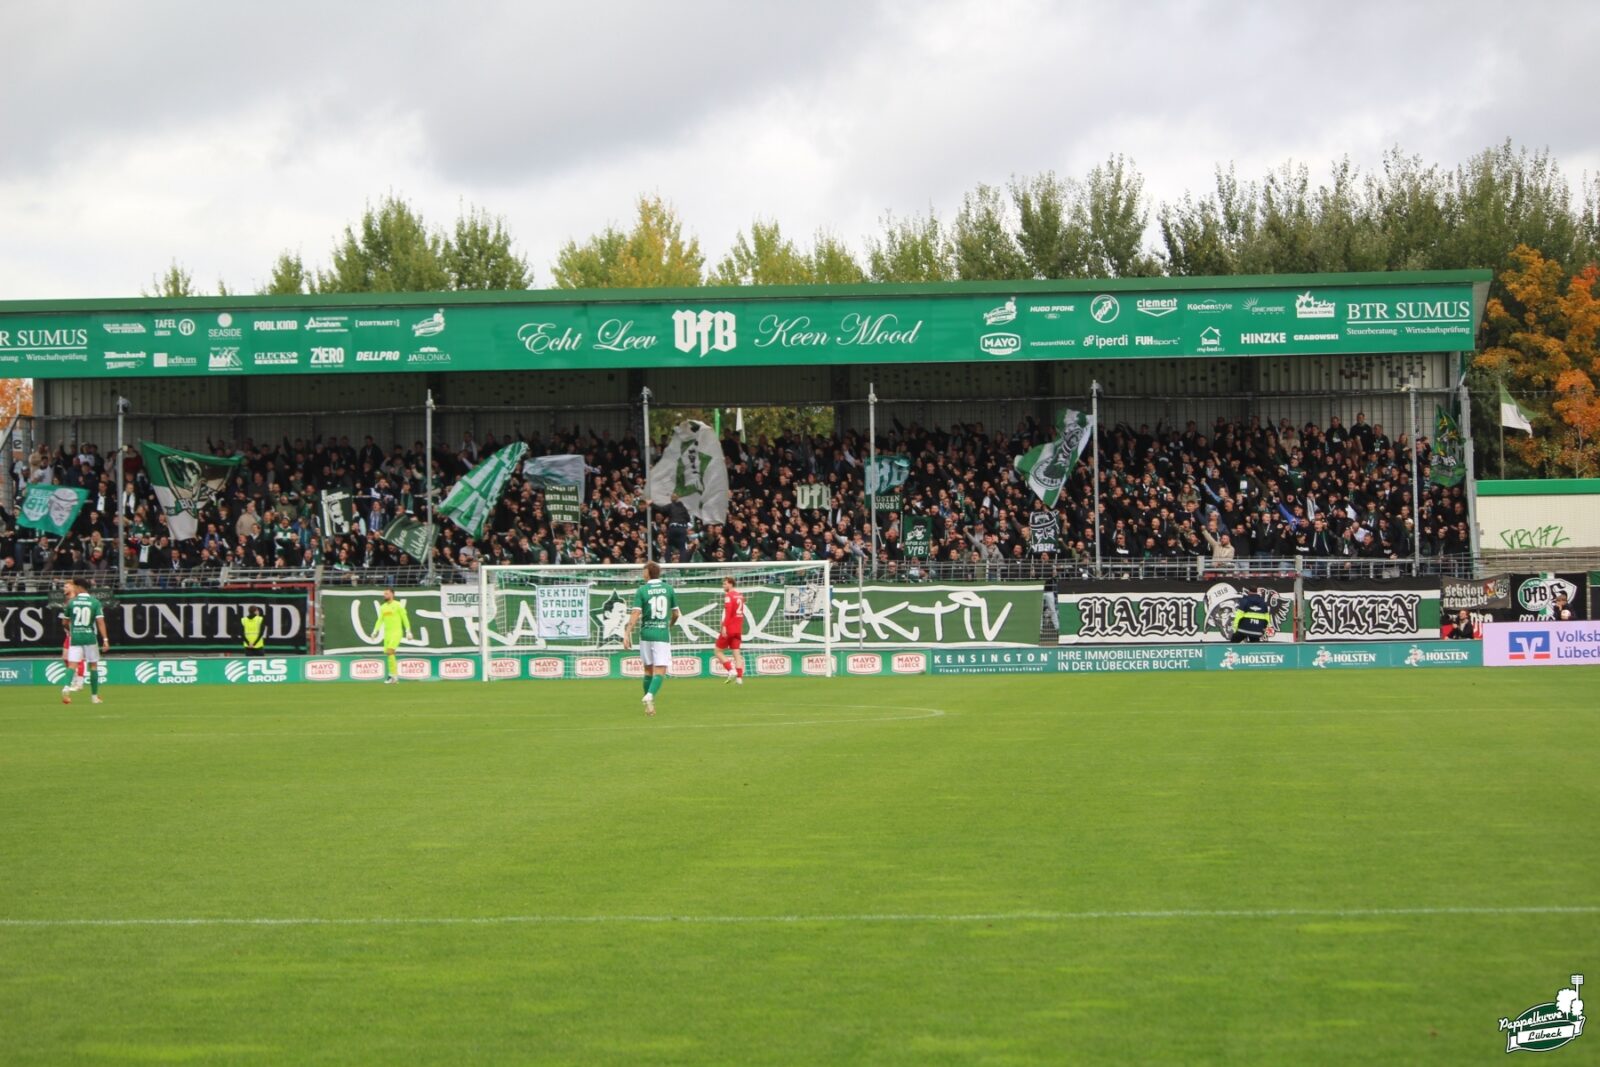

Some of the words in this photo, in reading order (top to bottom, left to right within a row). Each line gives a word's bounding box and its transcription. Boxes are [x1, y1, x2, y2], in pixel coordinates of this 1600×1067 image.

[1137, 298, 1178, 308] clement
[1187, 303, 1233, 312] Küchenstyle
[1346, 303, 1390, 319] BTR
[1395, 301, 1471, 319] SUMUS
[154, 319, 177, 328] TAFEL
[208, 328, 242, 337] SEASIDE
[672, 309, 737, 358] VfB
[754, 314, 831, 347] Keen
[836, 312, 924, 346] Mood
[1346, 327, 1398, 336] Steuerberatung
[1404, 326, 1471, 336] Wirtschaftsprüfung
[17, 329, 88, 346] SUMUS
[518, 322, 583, 354] Echt
[985, 337, 1017, 348] MAYO
[1096, 334, 1128, 348] iperdi
[1241, 332, 1287, 344] HINZKE
[356, 351, 400, 361] DELLPRO
[407, 353, 451, 362] JABLONKA
[540, 588, 586, 597] SEKTION
[542, 599, 583, 608] STADION
[648, 595, 668, 619] 19
[73, 606, 91, 626] 20
[542, 609, 583, 618] VERBOT
[1556, 630, 1600, 642] Volksb
[934, 653, 1048, 664] KENSINGTON
[1057, 650, 1081, 660] IHRE
[1084, 649, 1203, 660] IMMOBILIENEXPERTEN
[1241, 654, 1284, 664] HOLSTEN
[1333, 653, 1377, 663] HOLSTEN
[1425, 651, 1468, 662] HOLSTEN
[158, 660, 198, 676] FLS
[248, 659, 288, 675] FLS
[1057, 661, 1069, 670] IN
[1072, 661, 1093, 670] DER
[1096, 660, 1150, 671] LÜBECKER
[1153, 659, 1191, 670] BUCHT.
[158, 675, 198, 683] GROUP
[248, 674, 288, 682] GROUP
